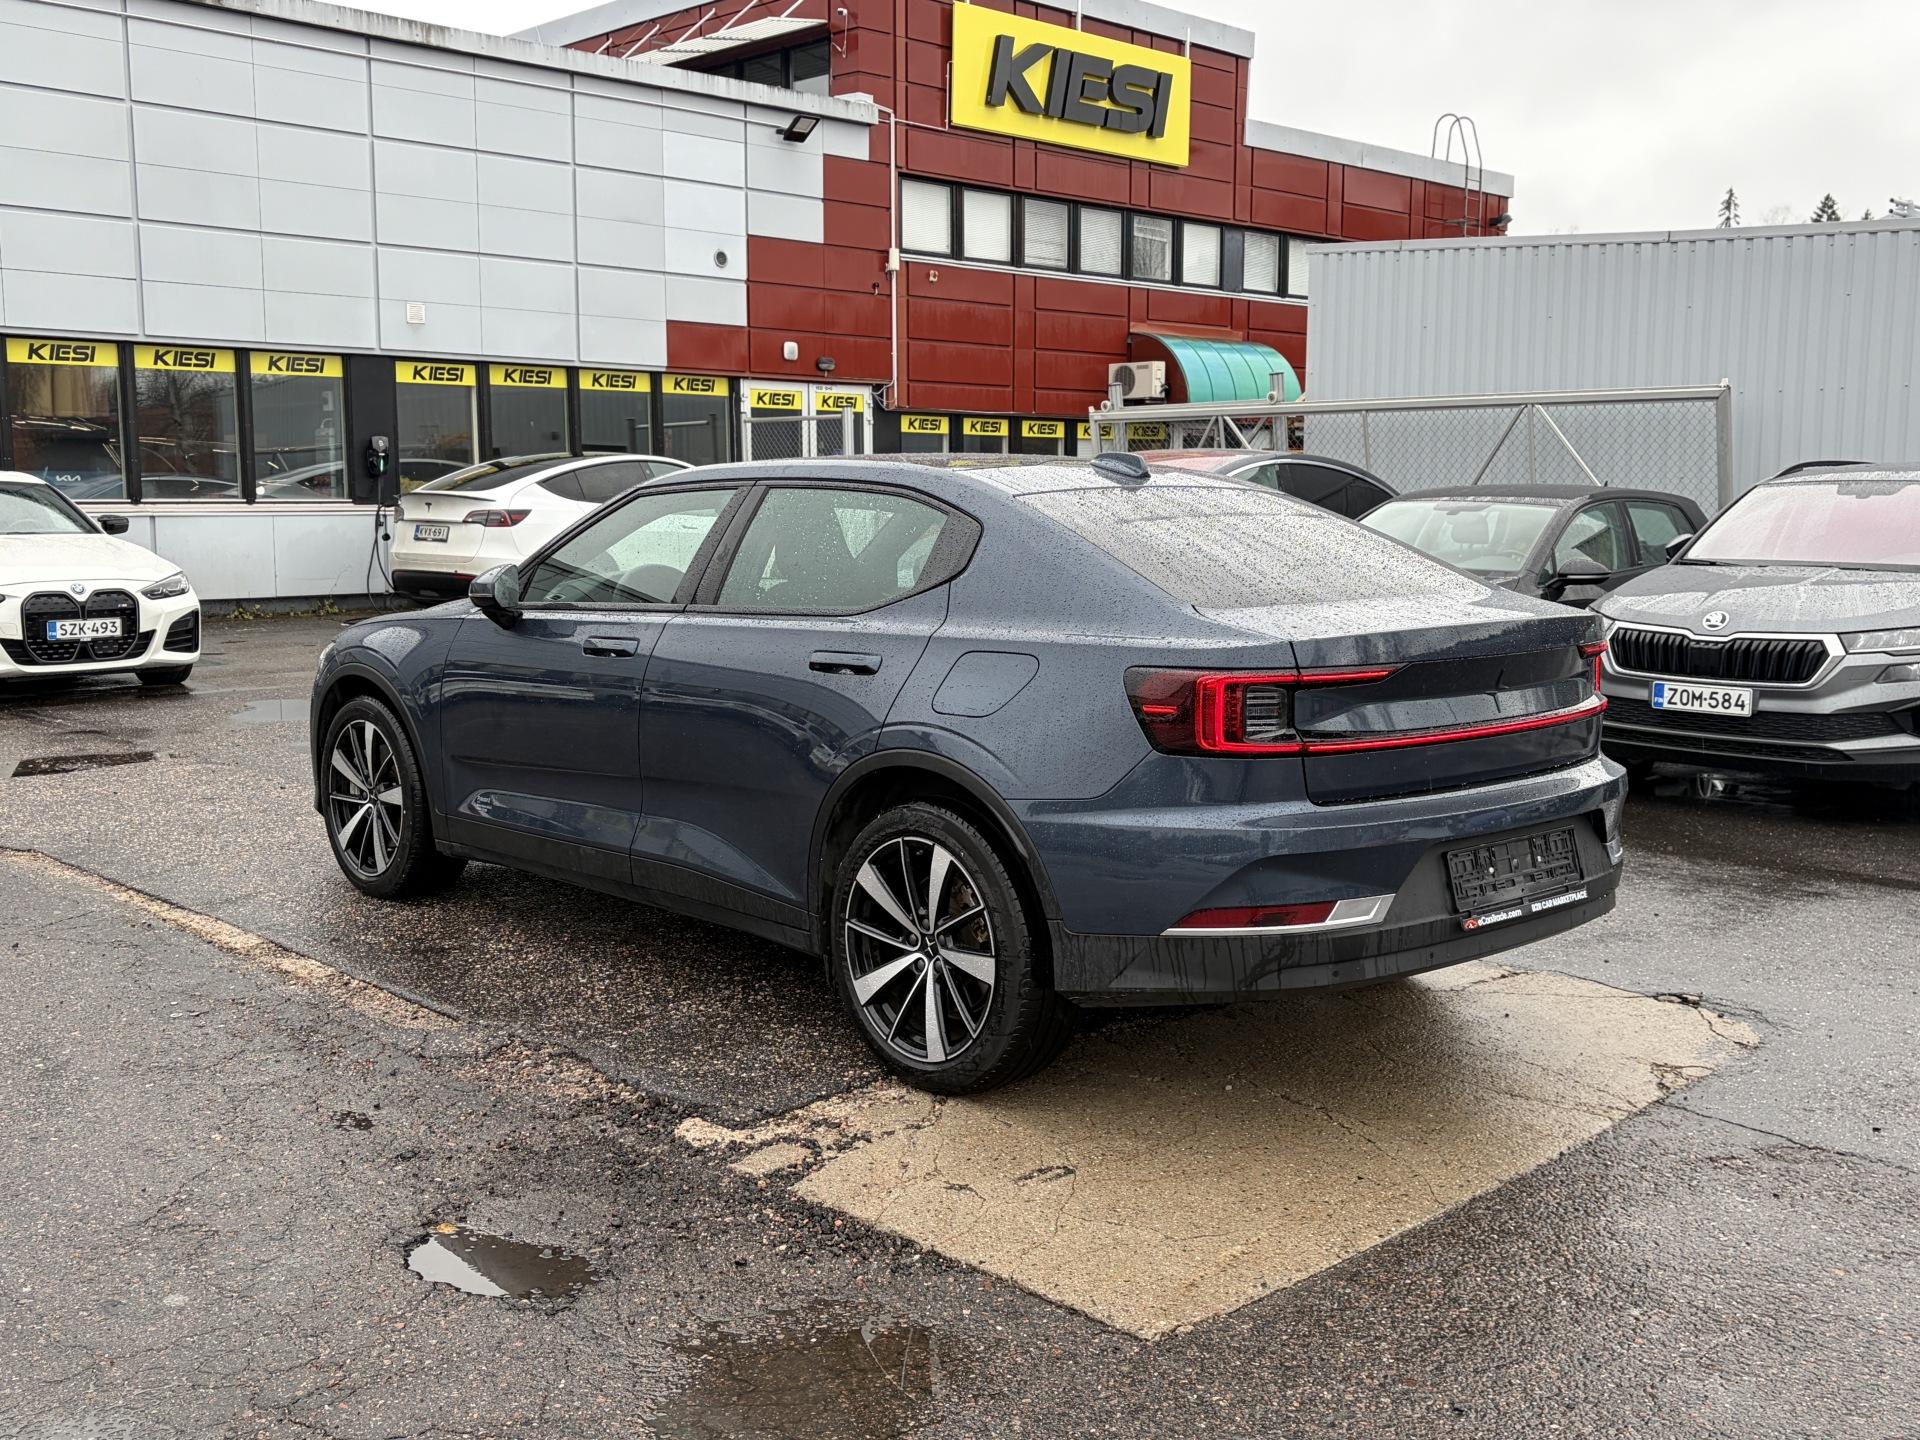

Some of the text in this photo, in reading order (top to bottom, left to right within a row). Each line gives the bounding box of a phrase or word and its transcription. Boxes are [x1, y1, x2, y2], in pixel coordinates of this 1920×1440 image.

[985, 34, 1174, 138] KIESI
[27, 342, 96, 363] KIESI
[153, 349, 216, 369] KIESI
[267, 355, 326, 374] KIESI
[412, 365, 465, 382] KIESI
[503, 368, 552, 385] KIESI
[591, 373, 637, 390] KIESI
[673, 376, 716, 392] KIESI
[756, 391, 796, 407] KIESI
[821, 394, 858, 409] KIESI
[908, 417, 942, 431] KIESI
[969, 420, 1002, 433] KIESI
[1028, 422, 1058, 435] KIESI
[1083, 425, 1112, 437] KSI
[59, 621, 118, 636] SZK-493
[1666, 687, 1746, 711] ZOM-584
